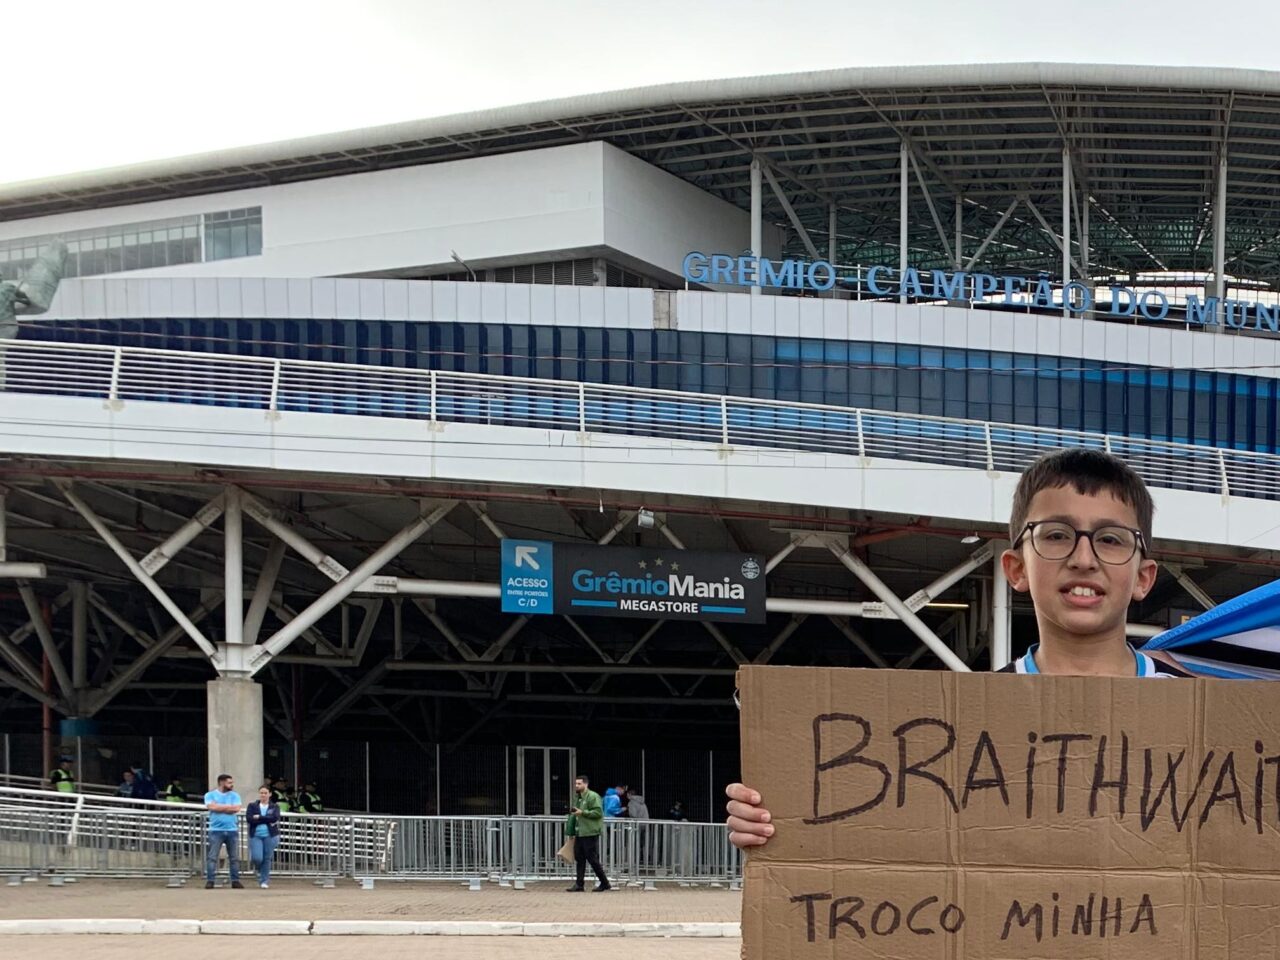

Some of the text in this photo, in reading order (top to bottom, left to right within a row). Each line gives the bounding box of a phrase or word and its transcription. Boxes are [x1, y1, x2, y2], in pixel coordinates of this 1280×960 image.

[683, 250, 837, 292] GRÊMIO
[867, 265, 1092, 314] CAMPEÃO
[1108, 285, 1169, 321] DO
[507, 577, 548, 588] ACESSO
[571, 569, 745, 600] GrêmioMania
[518, 597, 538, 607] C/D
[620, 600, 699, 614] MEGASTORE
[790, 894, 966, 943] TROCO
